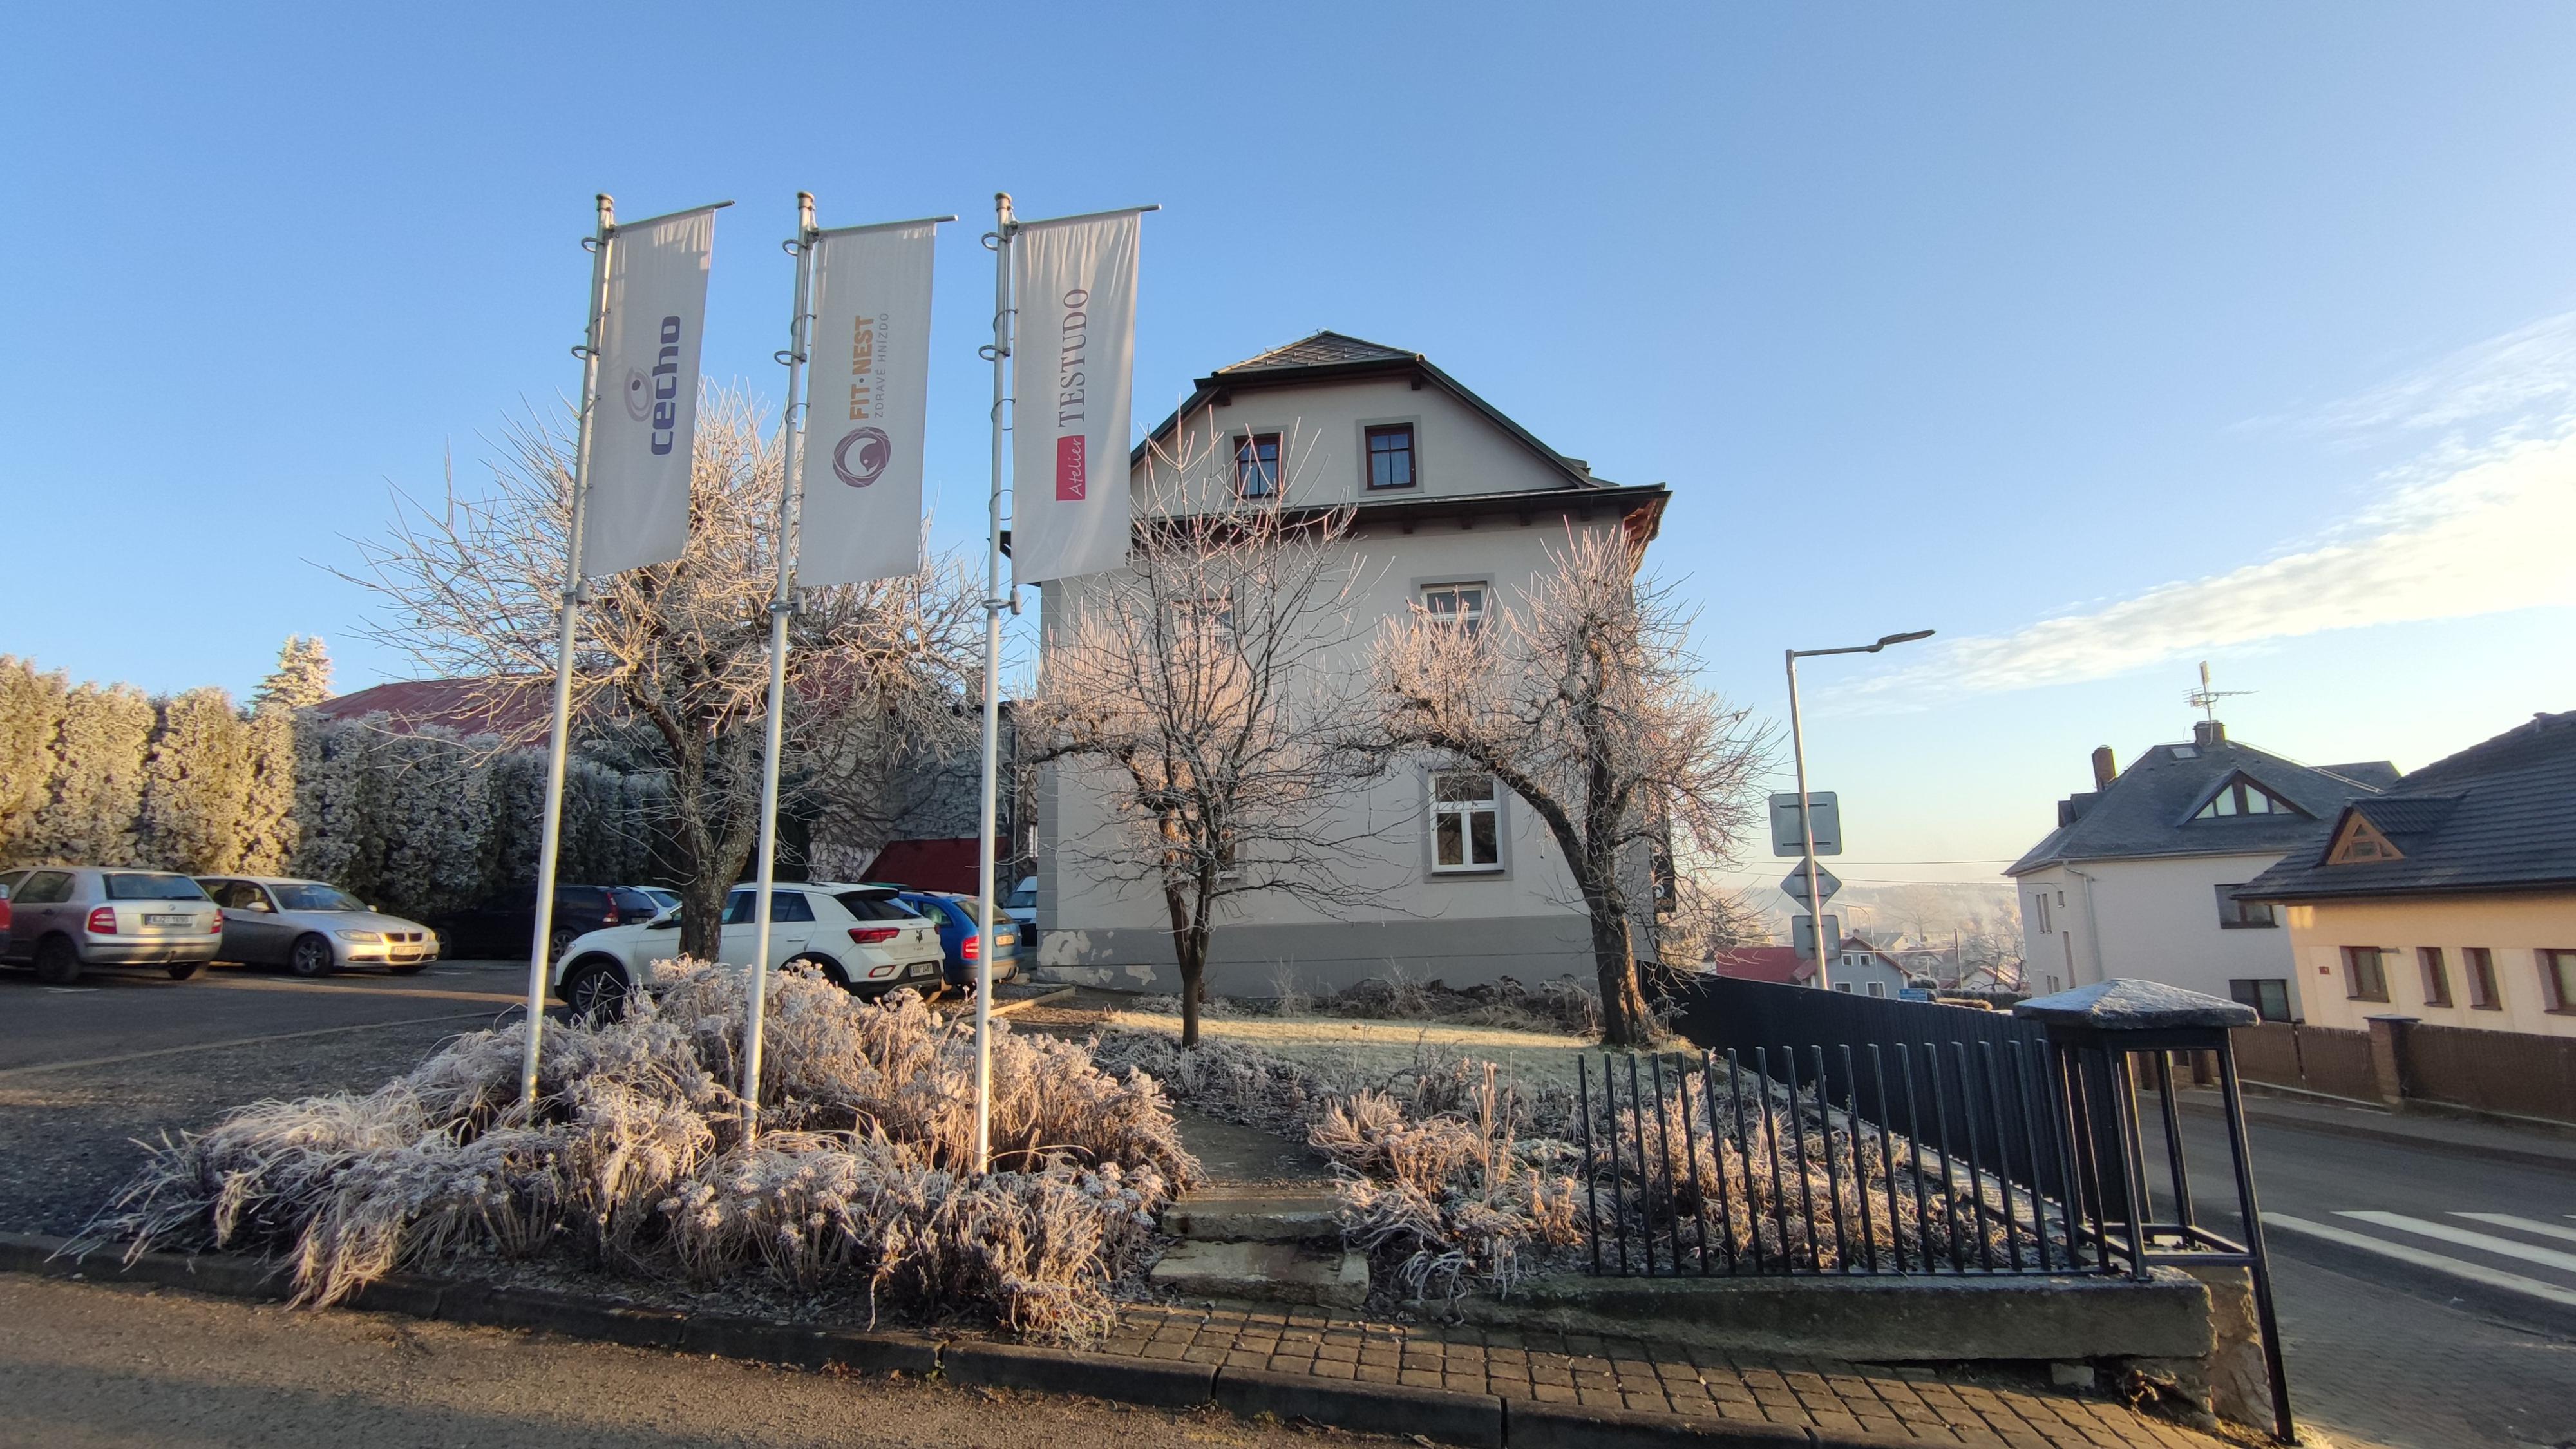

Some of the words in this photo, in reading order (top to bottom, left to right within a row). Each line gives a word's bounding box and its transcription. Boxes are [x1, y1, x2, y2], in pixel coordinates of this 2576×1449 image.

[878, 312, 889, 362] HNÍZDO
[1058, 289, 1088, 428] TESTUDO
[651, 316, 681, 455] cecho
[875, 368, 886, 418] ZDRAVÉ
[1068, 438, 1083, 496] Atelier
